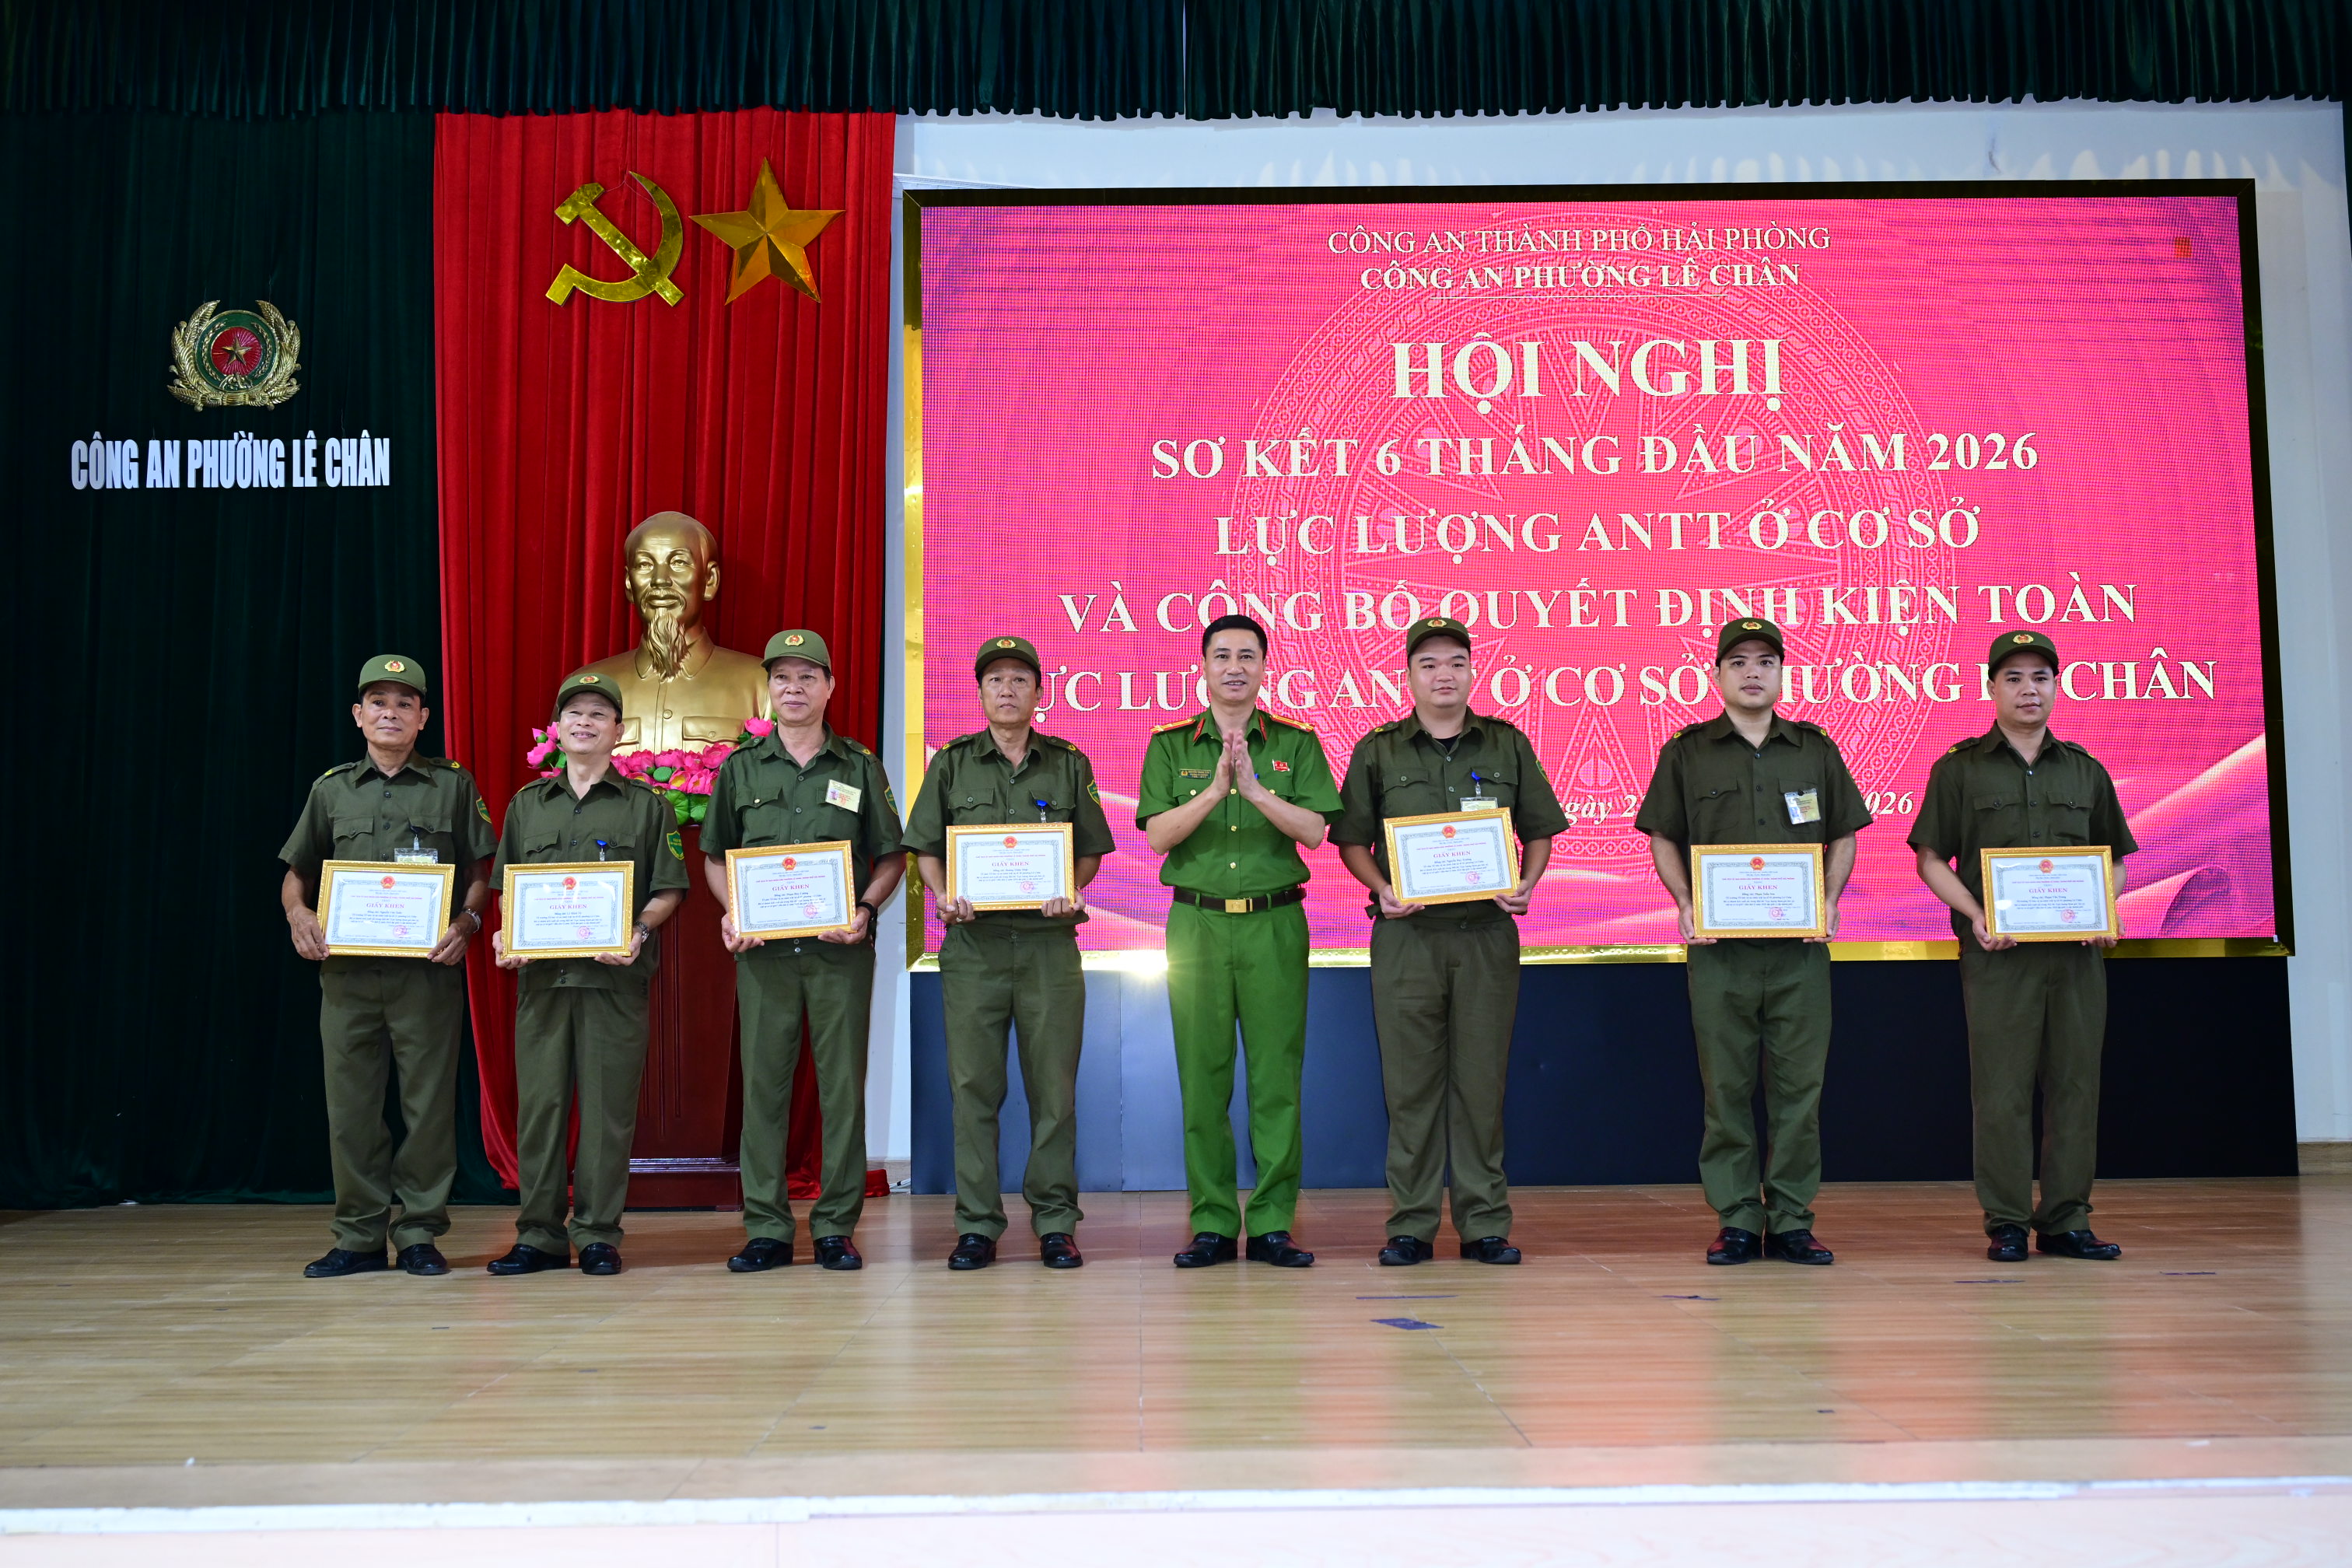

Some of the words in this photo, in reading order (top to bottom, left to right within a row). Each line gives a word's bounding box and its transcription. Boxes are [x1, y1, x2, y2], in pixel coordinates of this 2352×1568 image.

[1328, 224, 1416, 254] CÔNG
[1422, 231, 1468, 253] AN
[1474, 223, 1583, 253] THÀNH
[1591, 223, 1654, 251] PHỐ
[1661, 221, 1717, 250] HẢI
[1724, 220, 1831, 250] PHÒNG
[1360, 260, 1454, 290] CÔNG
[1459, 266, 1506, 289] AN
[1512, 261, 1652, 289] PHƯỜNG
[1658, 257, 1700, 287] LÊ
[1709, 256, 1801, 286] CHÂN
[1387, 331, 1547, 415] HỘI
[1568, 338, 1789, 412] NGHỊ
[71, 431, 139, 490] CÔNG
[145, 439, 181, 488] AN
[187, 430, 285, 489] PHƯỜNG
[292, 429, 318, 488] LÊ
[324, 429, 390, 488] CHÂN
[1152, 436, 1226, 479] SƠ
[1241, 427, 1358, 478] KẾT
[1376, 439, 1402, 476] 6
[1417, 424, 1623, 476] THÁNG
[1638, 423, 1759, 474] ĐẦU
[1775, 422, 1909, 473] NĂM
[1926, 432, 2038, 471] 2026
[1213, 509, 1334, 566] LỰC
[1352, 508, 1563, 565] LƯỢNG
[1575, 512, 1731, 551] ANTT
[1748, 498, 1791, 550] Ở
[1807, 506, 1891, 549] CƠ
[1907, 496, 1981, 548] SỞ
[1057, 580, 1139, 633] VÀ
[1157, 579, 1325, 634] CÔNG
[1342, 579, 1421, 631] BỐ
[1439, 577, 1637, 638] QUYẾT
[1654, 587, 1803, 639] ĐỊNH
[1817, 579, 1961, 636] KIỆN
[1977, 571, 2138, 624] TOÀN
[1034, 665, 1102, 723] ỰC
[1328, 668, 1477, 709] AN
[1490, 655, 1533, 708] Ở
[1545, 663, 1626, 706] CƠ
[1639, 653, 1711, 705] SỞ
[2060, 646, 2217, 701] CHÂN
[1559, 794, 1613, 826] gày
[1862, 791, 1914, 815] 026
